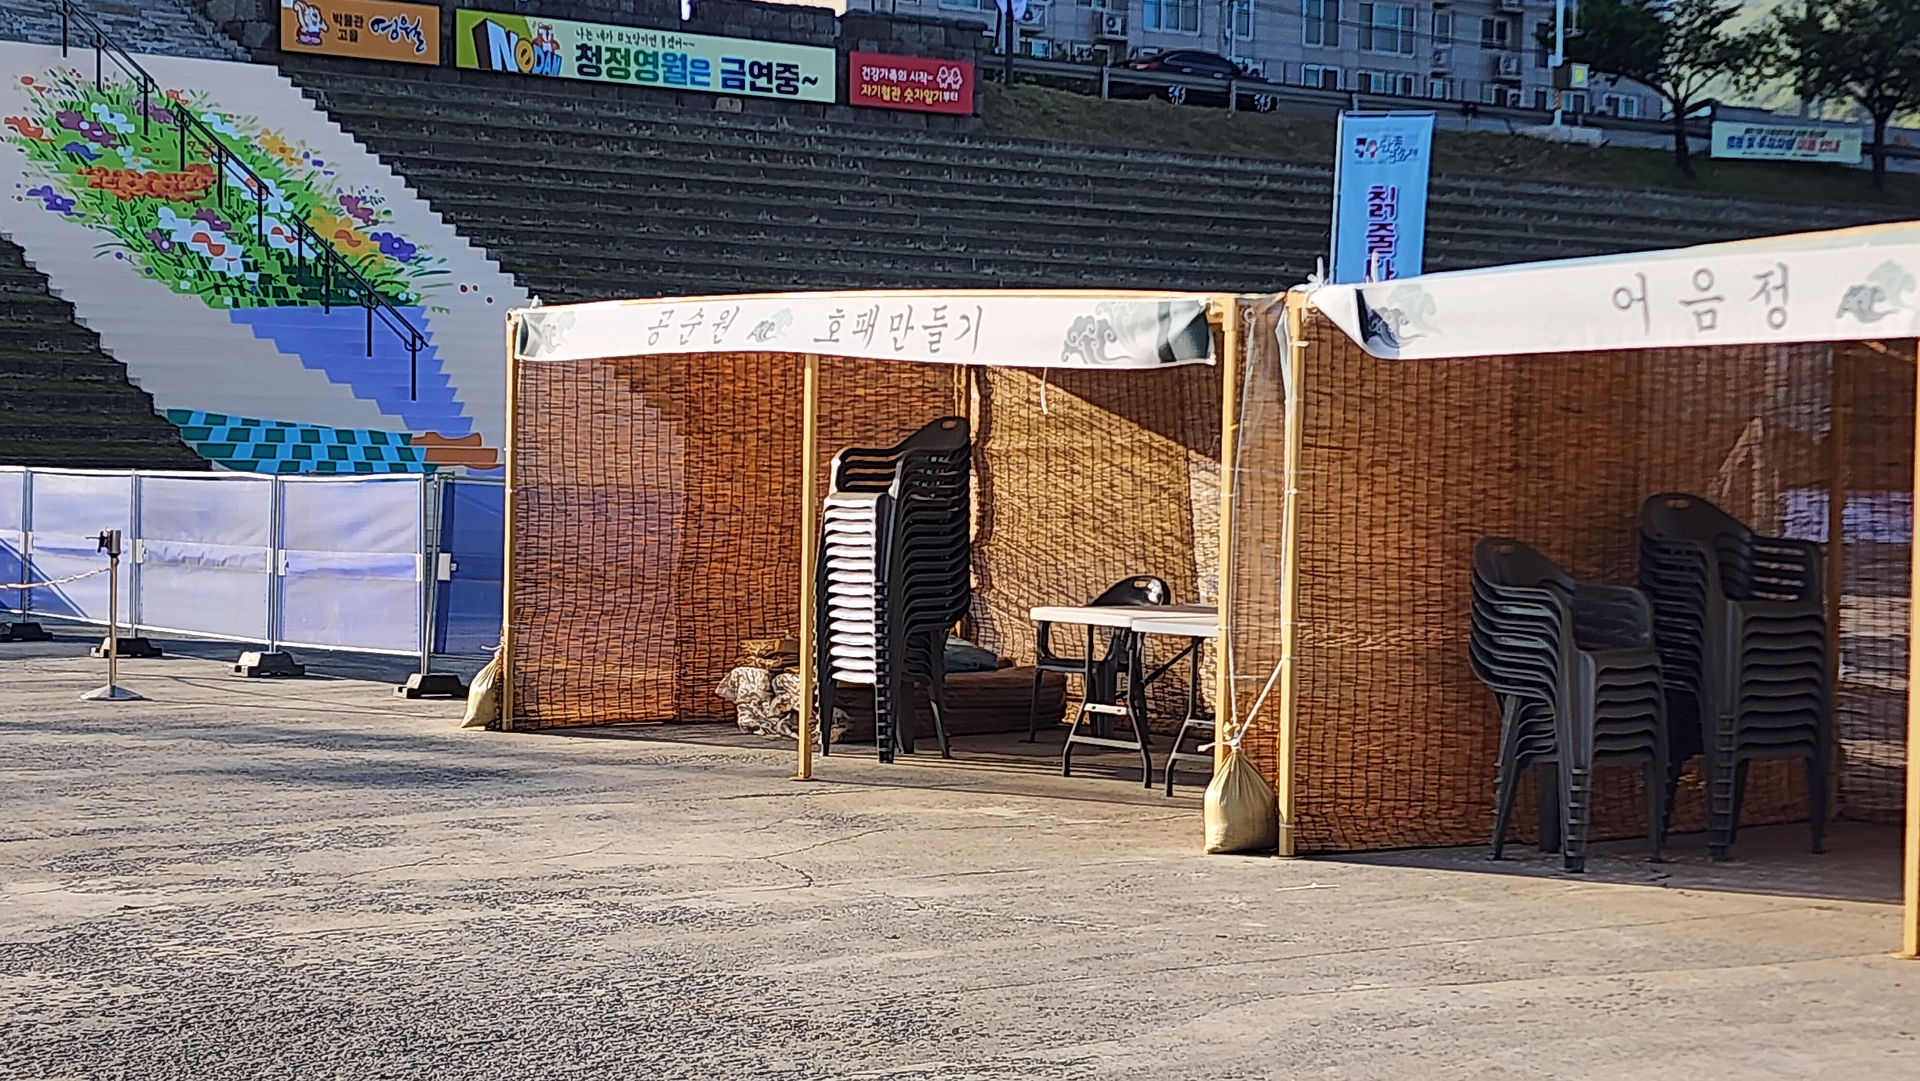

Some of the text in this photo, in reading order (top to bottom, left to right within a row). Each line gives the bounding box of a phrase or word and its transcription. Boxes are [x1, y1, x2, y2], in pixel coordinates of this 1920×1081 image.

[332, 12, 363, 29] 박물관
[337, 29, 359, 43] 고을
[369, 14, 427, 54] 영월
[576, 27, 593, 41] 나는
[575, 43, 819, 95] 청정영월은 금연중~
[861, 66, 907, 83] 건강가족의
[861, 84, 958, 105] 자기혈관 숫자알기부터
[1612, 262, 1790, 335] 어음정
[648, 304, 983, 355] 공순원 호패만들기
